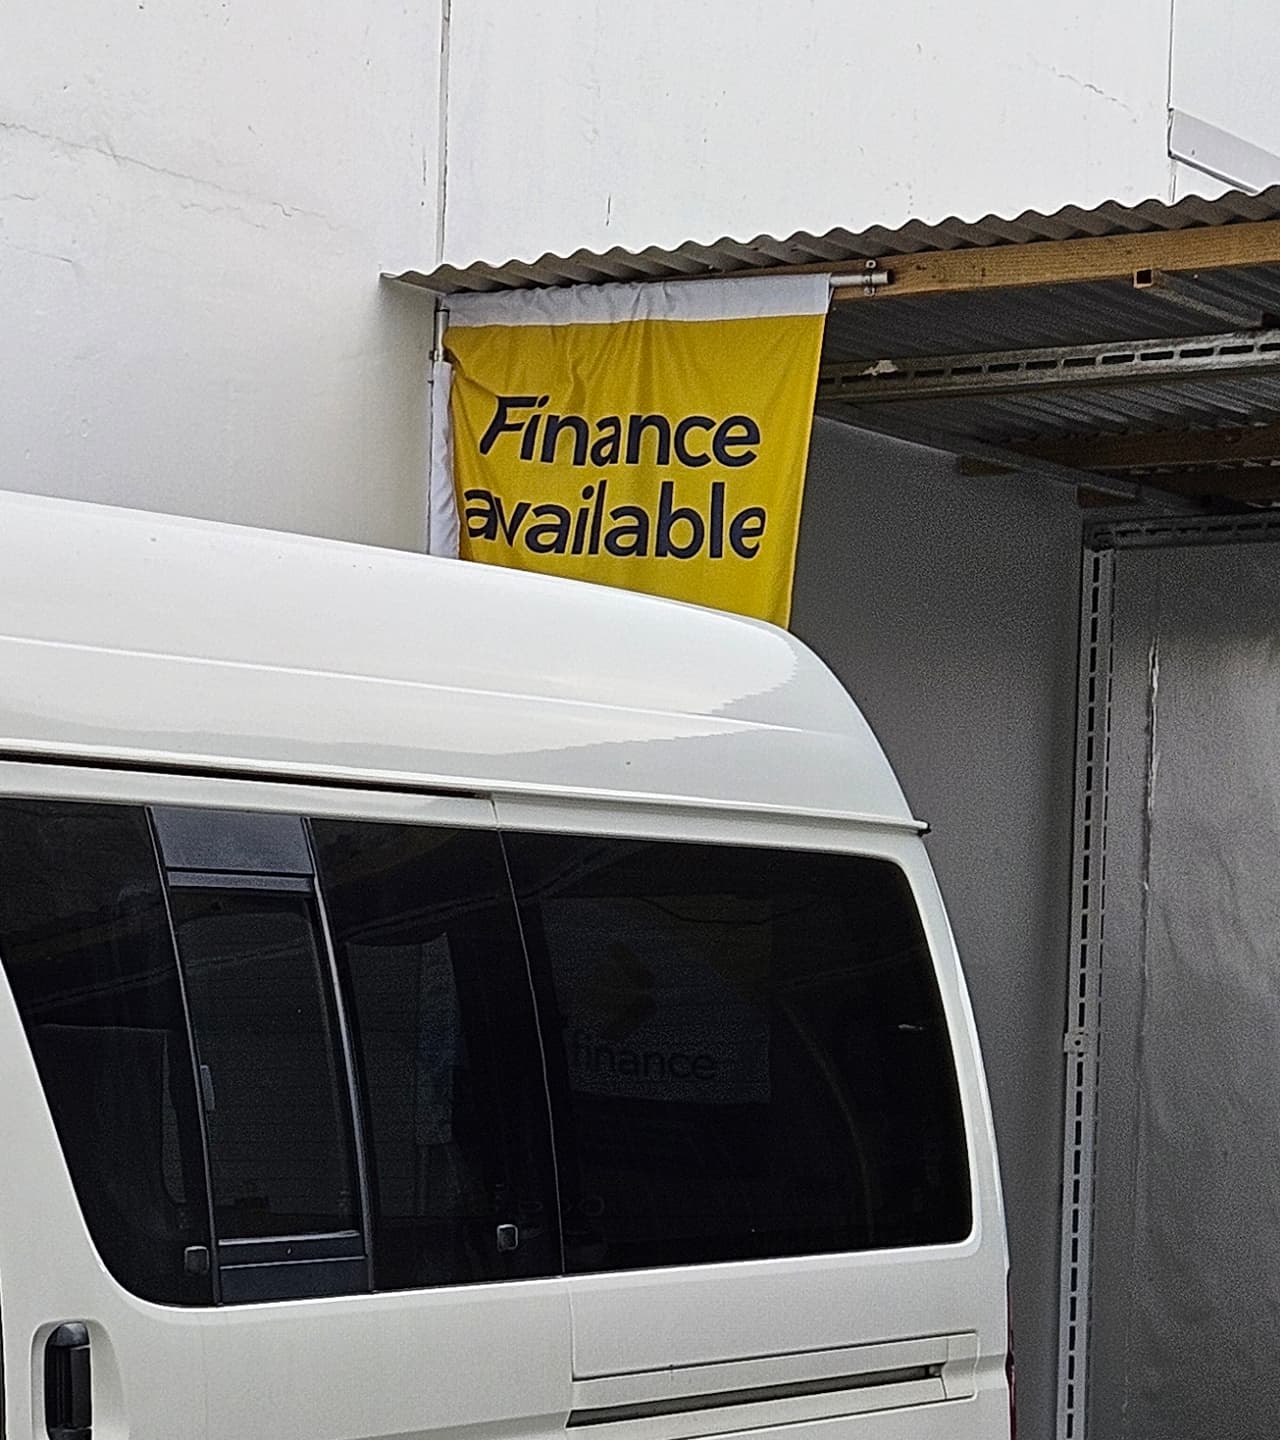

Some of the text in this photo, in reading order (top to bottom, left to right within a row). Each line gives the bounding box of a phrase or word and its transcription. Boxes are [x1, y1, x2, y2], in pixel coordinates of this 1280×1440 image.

[480, 395, 761, 467] Finance
[463, 480, 767, 560] available
[571, 1029, 719, 1081] finance
